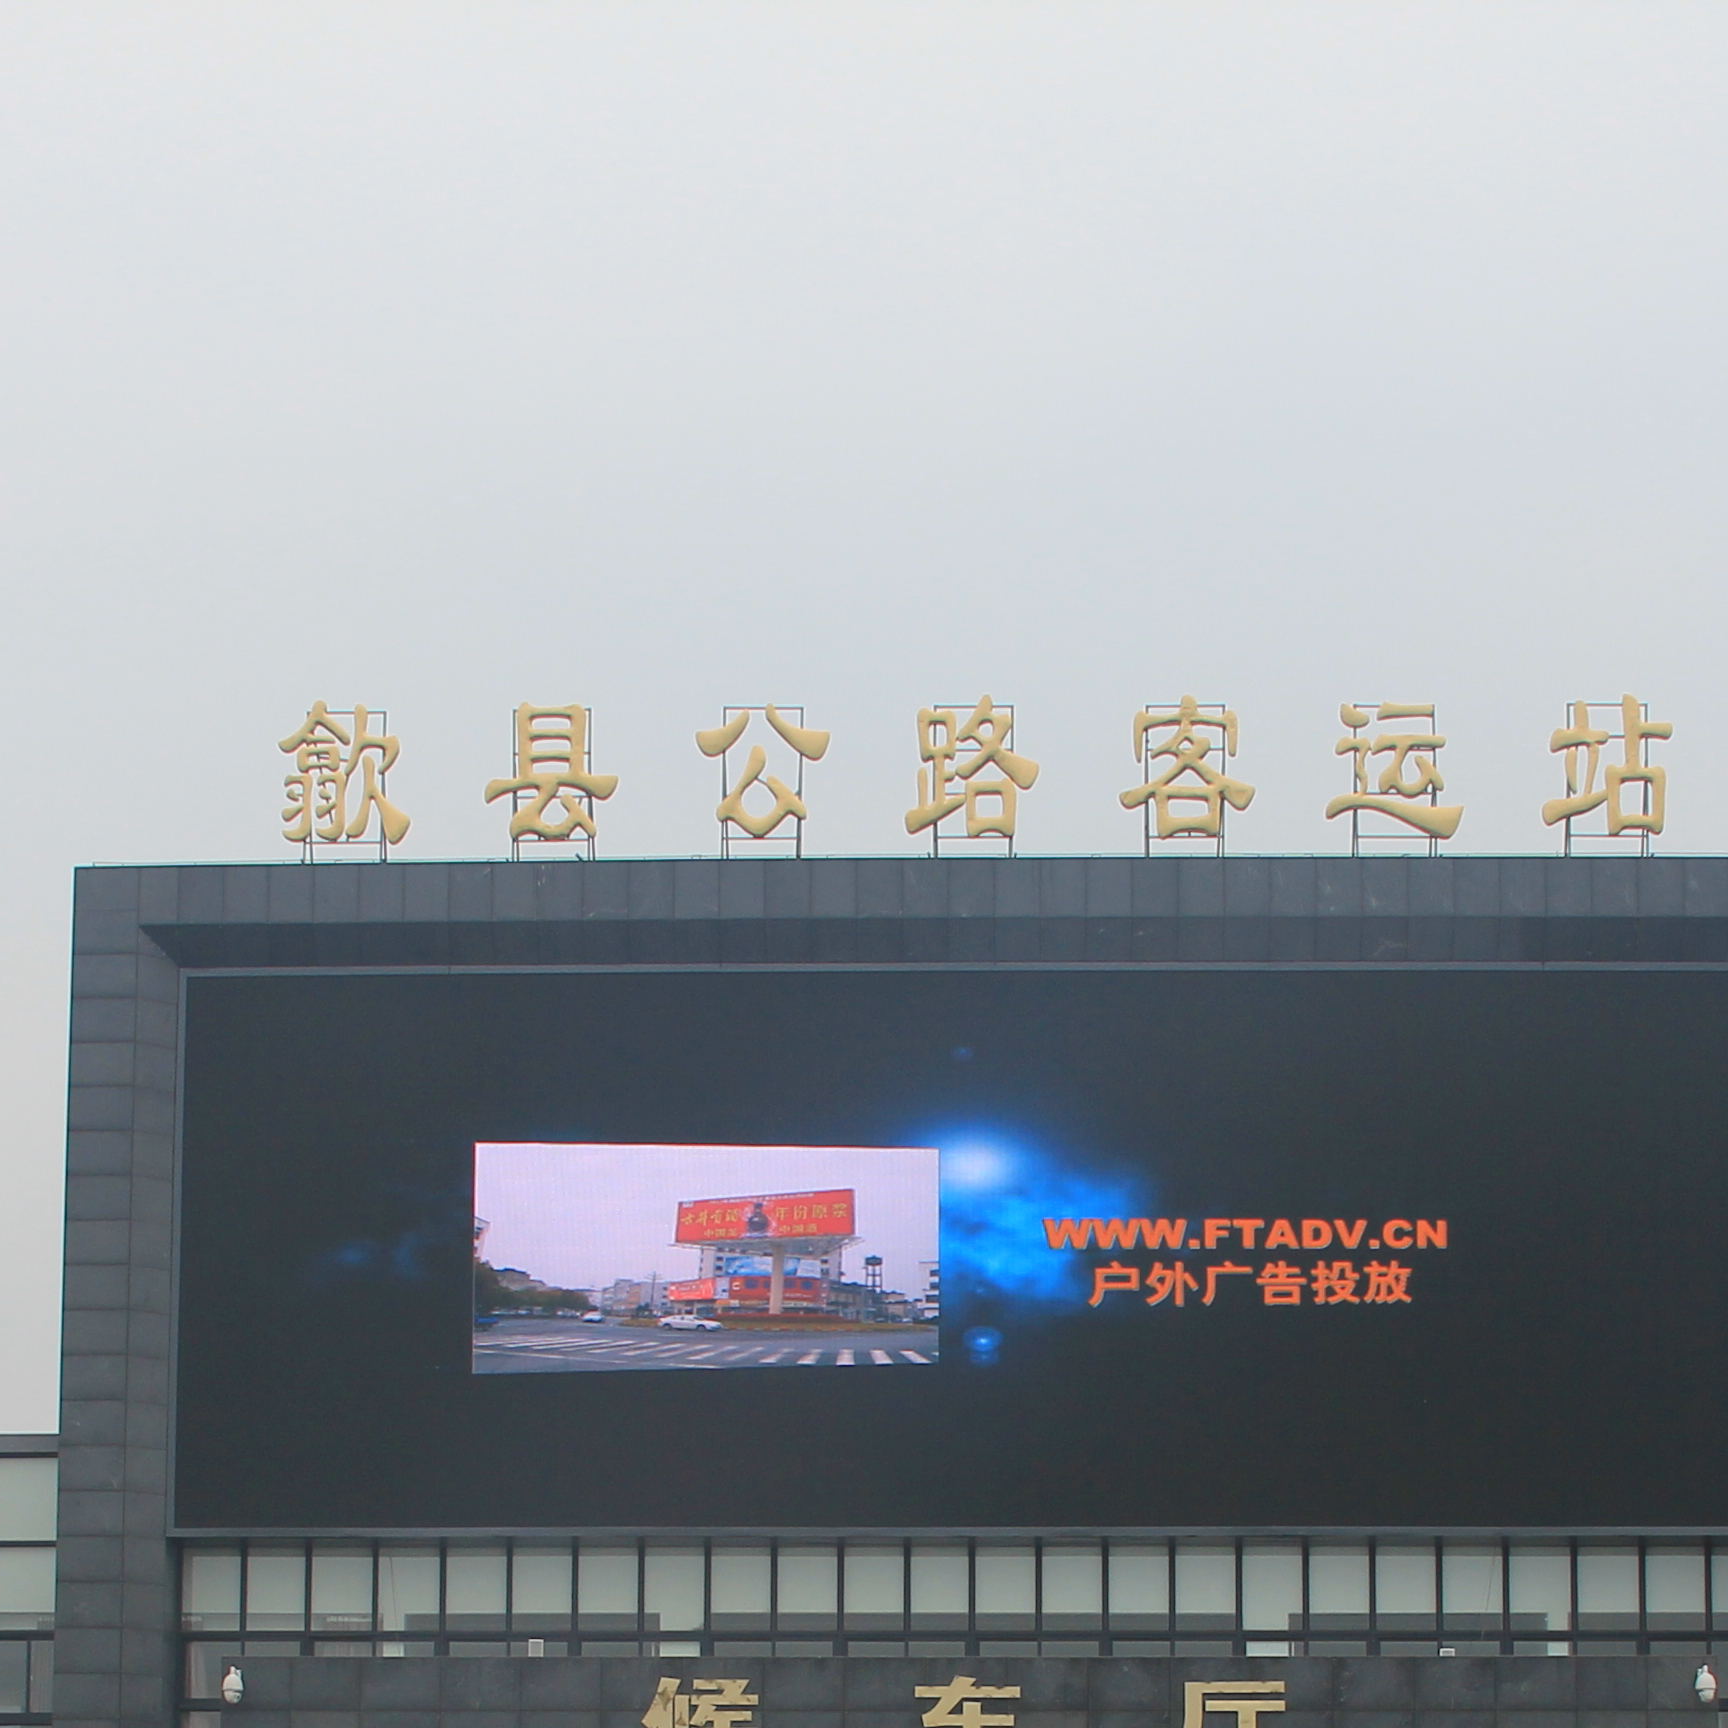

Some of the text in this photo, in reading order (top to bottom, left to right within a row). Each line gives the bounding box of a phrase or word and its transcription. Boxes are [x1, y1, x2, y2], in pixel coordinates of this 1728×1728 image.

[278, 695, 1673, 846] 歙县公路客运站
[1043, 1217, 1448, 1249] WWW.FTADV.CN
[1088, 1260, 1414, 1307] 户外广告投放
